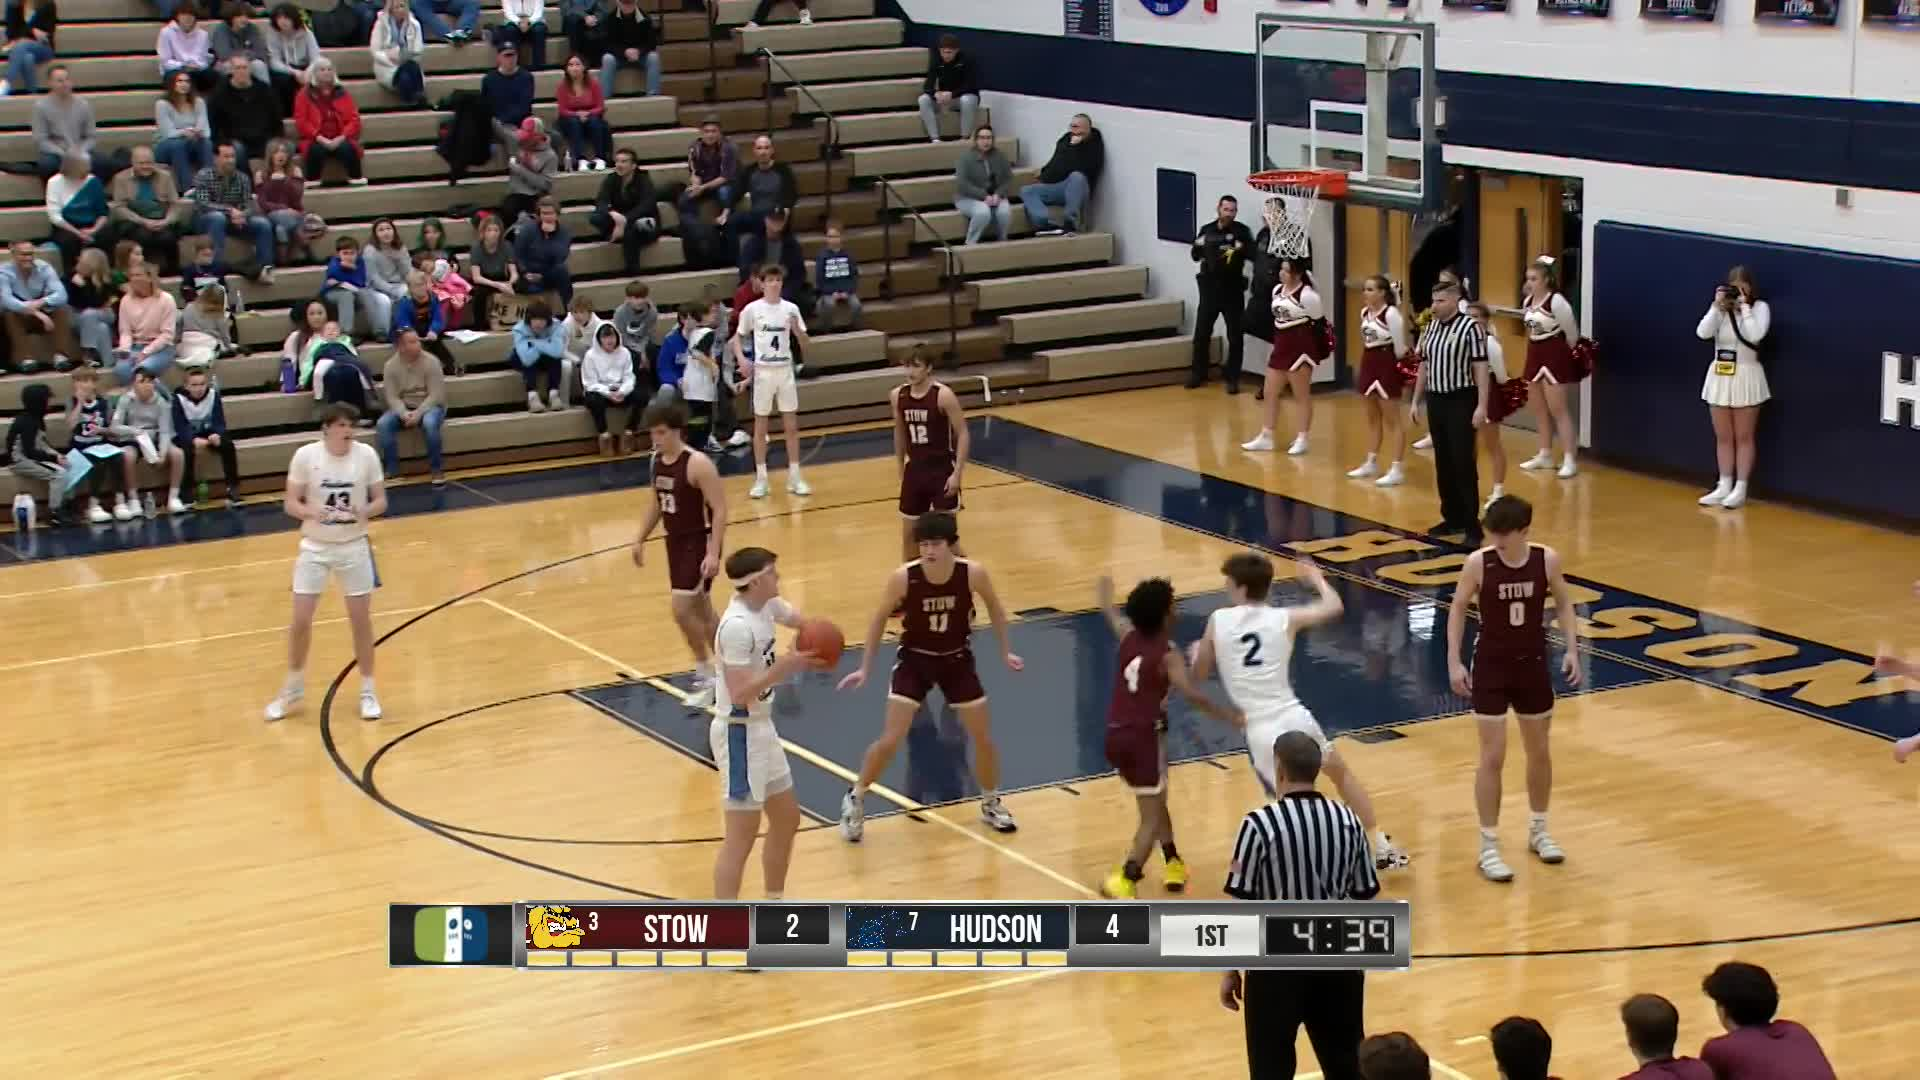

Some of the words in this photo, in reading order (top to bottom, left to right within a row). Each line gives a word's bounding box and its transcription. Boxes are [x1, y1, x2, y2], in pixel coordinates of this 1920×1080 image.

[770, 335, 780, 351] 4
[909, 424, 928, 444] 12
[1498, 581, 1535, 600] STOW
[922, 596, 956, 611] STOW
[1509, 601, 1525, 626] 0
[929, 613, 948, 632] 11
[1283, 530, 1918, 708] HUSON
[1240, 631, 1264, 667] 2
[1123, 655, 1143, 694] 4
